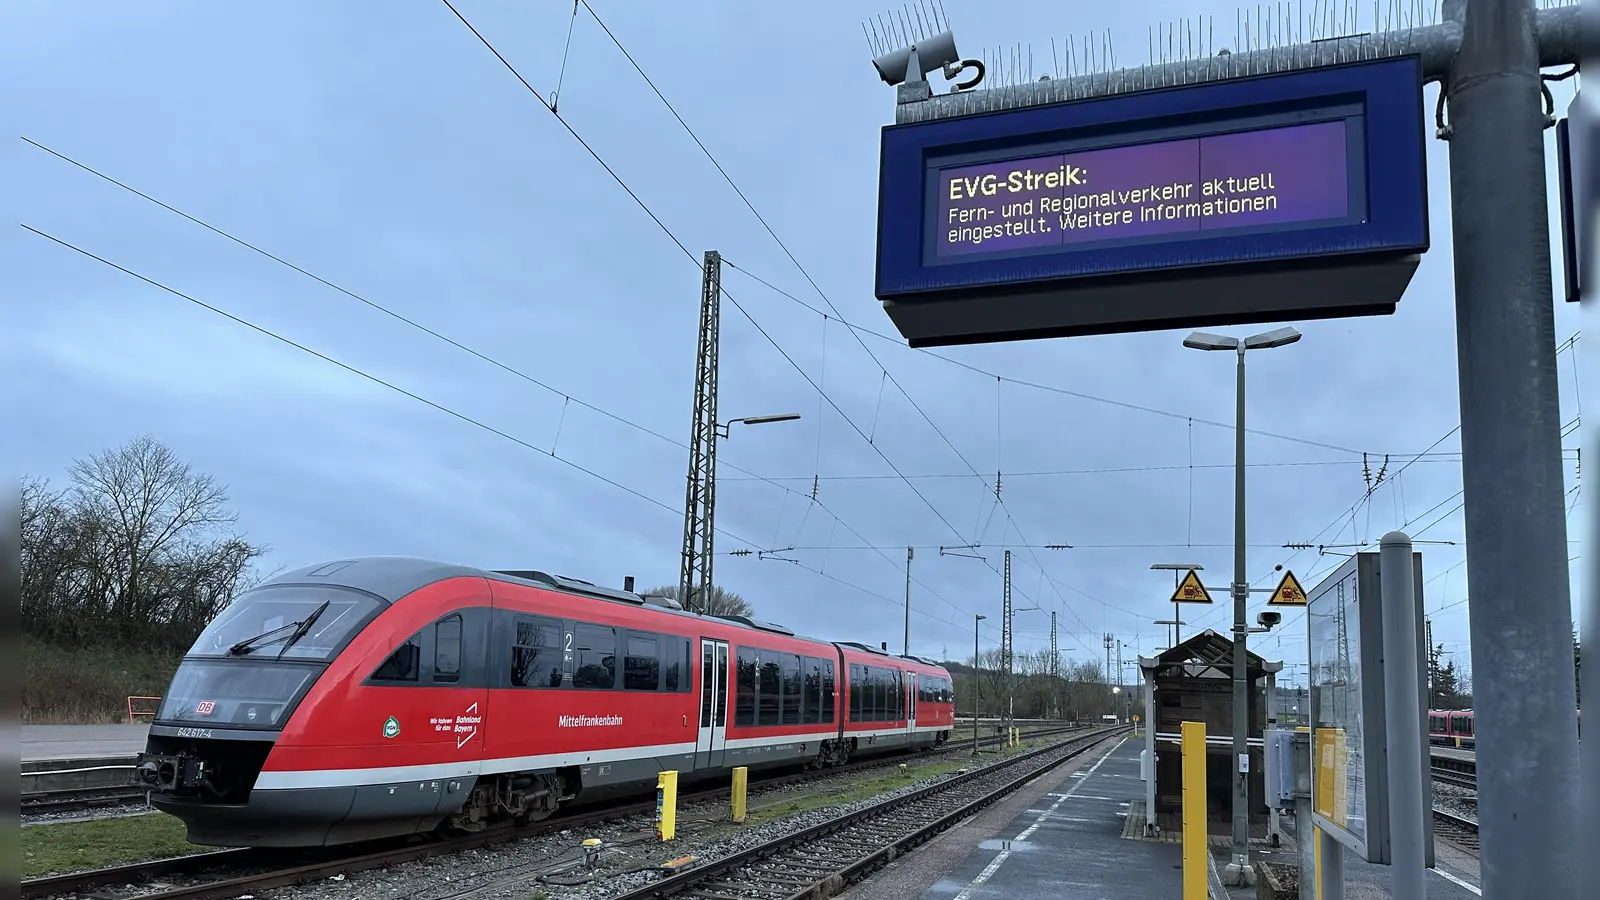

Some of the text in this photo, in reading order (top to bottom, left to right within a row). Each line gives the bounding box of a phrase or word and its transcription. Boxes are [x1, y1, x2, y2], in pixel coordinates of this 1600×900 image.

[949, 164, 1087, 200] EVG-Streik:
[949, 172, 1275, 224] Fern- und Regionalverkehr aktuell
[948, 194, 1277, 244] eingestellt. Weitere Informationen
[565, 633, 573, 652] 2
[197, 702, 214, 713] DB
[456, 715, 482, 724] Bahnland
[558, 714, 623, 728] Mittelfrankenbahn
[177, 727, 213, 738] 642 617-4
[454, 724, 473, 734] Bayern
